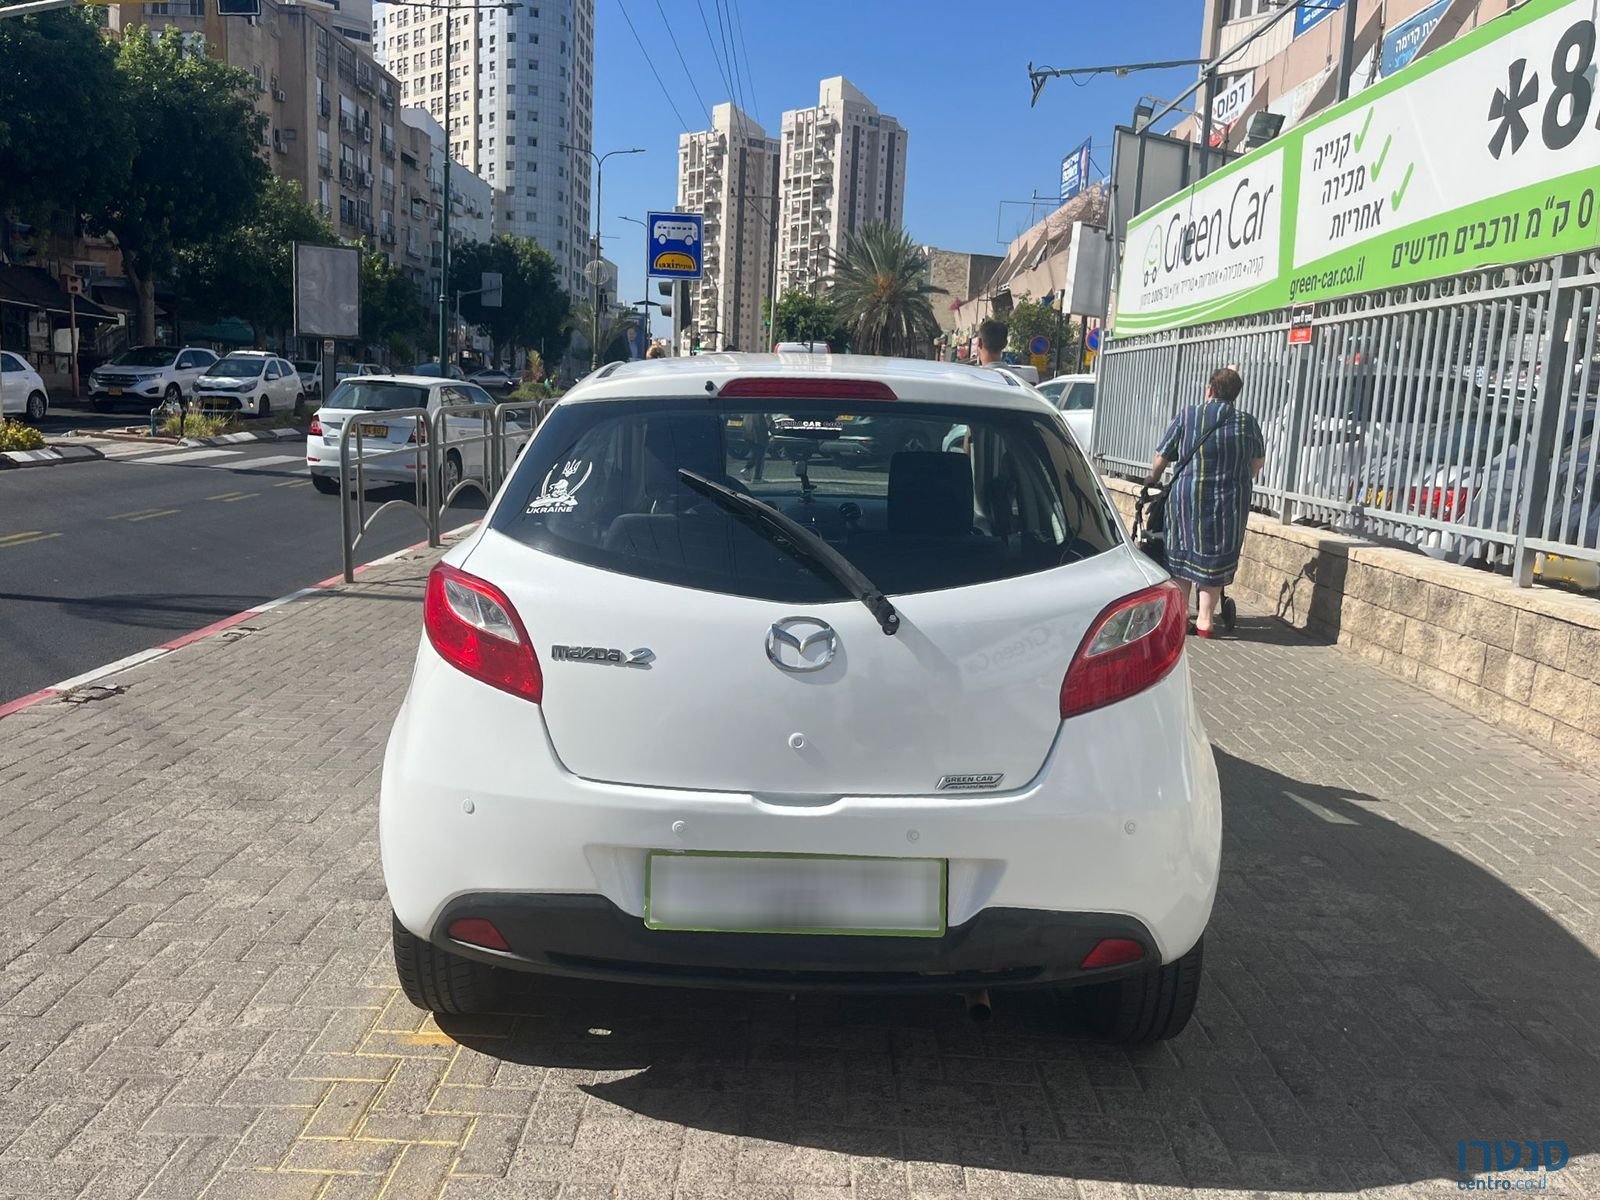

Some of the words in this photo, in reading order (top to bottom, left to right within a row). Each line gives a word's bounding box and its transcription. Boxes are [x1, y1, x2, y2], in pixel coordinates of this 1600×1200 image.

[1216, 83, 1246, 118] דפוס
[1313, 132, 1351, 171] קנייה
[1322, 165, 1366, 205] מכירה
[1164, 208, 1222, 273] Green
[1228, 178, 1274, 250] Car
[1329, 198, 1384, 240] אחריות
[1453, 212, 1520, 254] ורכבים
[1391, 231, 1449, 269] חדשים
[1289, 256, 1366, 300] green-car.co.il
[525, 506, 574, 514] UKRAINE
[624, 647, 656, 665] 2
